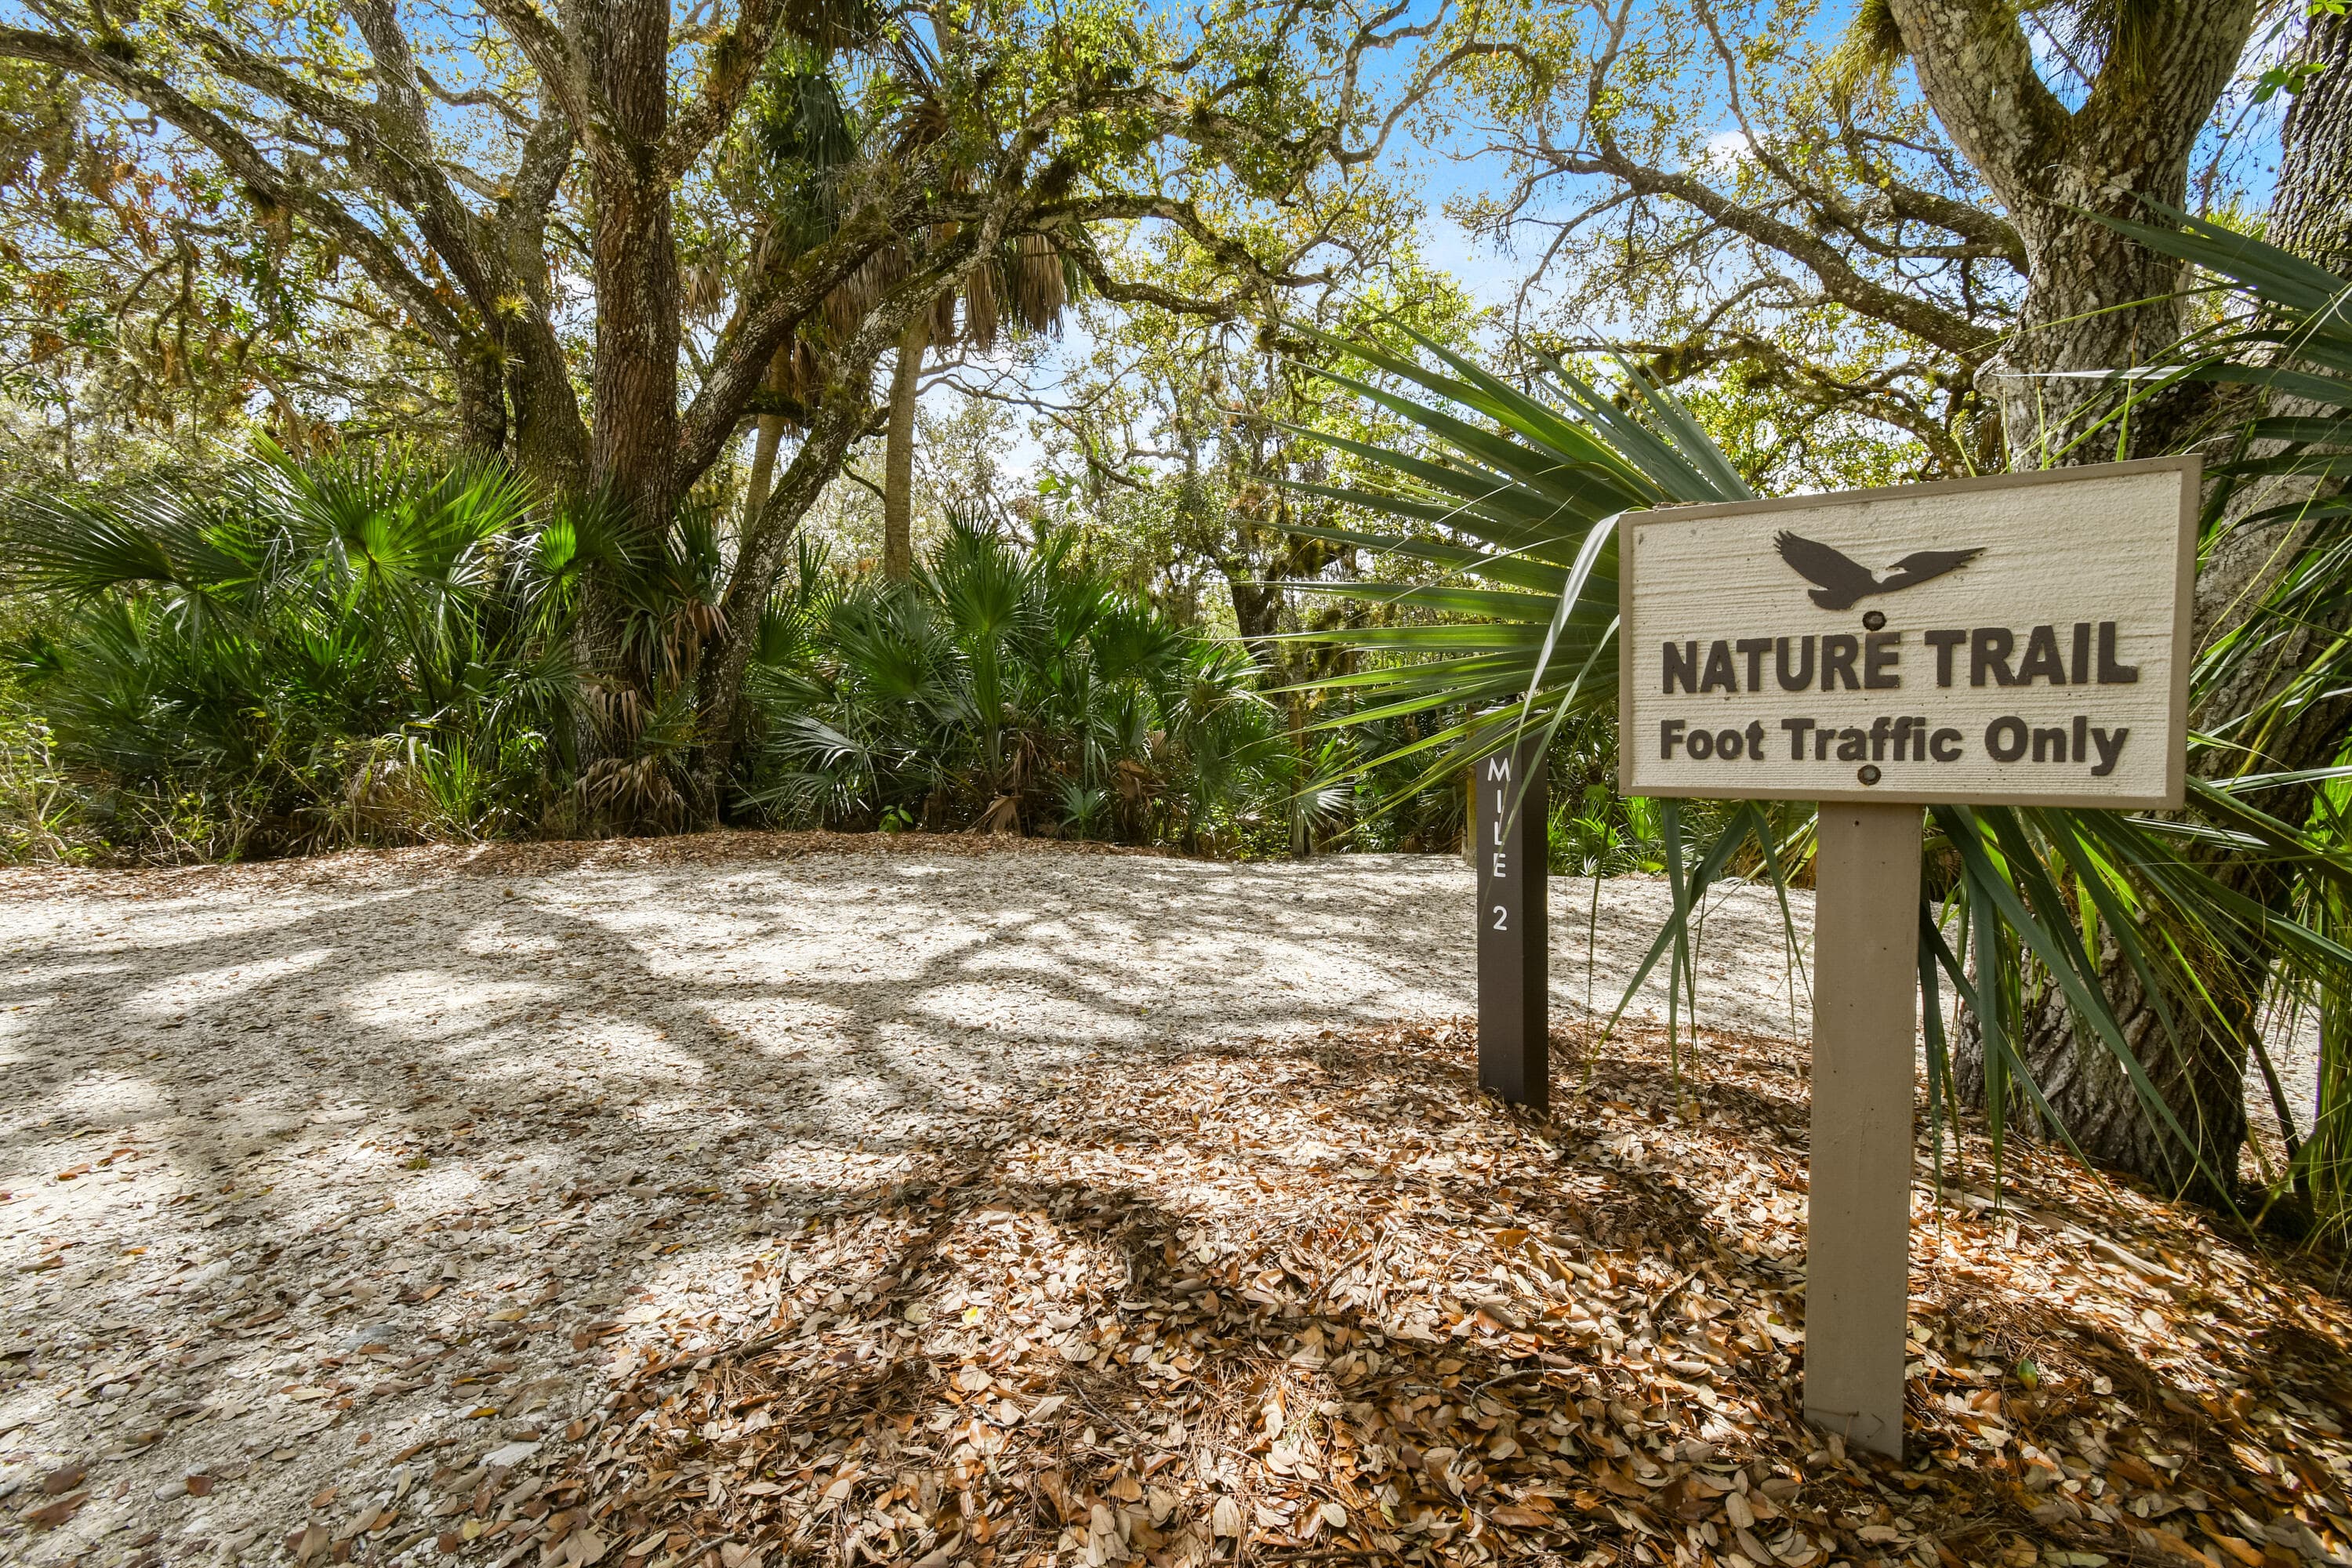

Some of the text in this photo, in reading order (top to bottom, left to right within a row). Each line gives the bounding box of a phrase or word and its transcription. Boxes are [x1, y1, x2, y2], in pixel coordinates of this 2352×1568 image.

[1662, 622, 2138, 694] NATURE TRAIL
[1660, 715, 2129, 776] Foot Traffic Only
[1487, 757, 1511, 931] MILE 2
